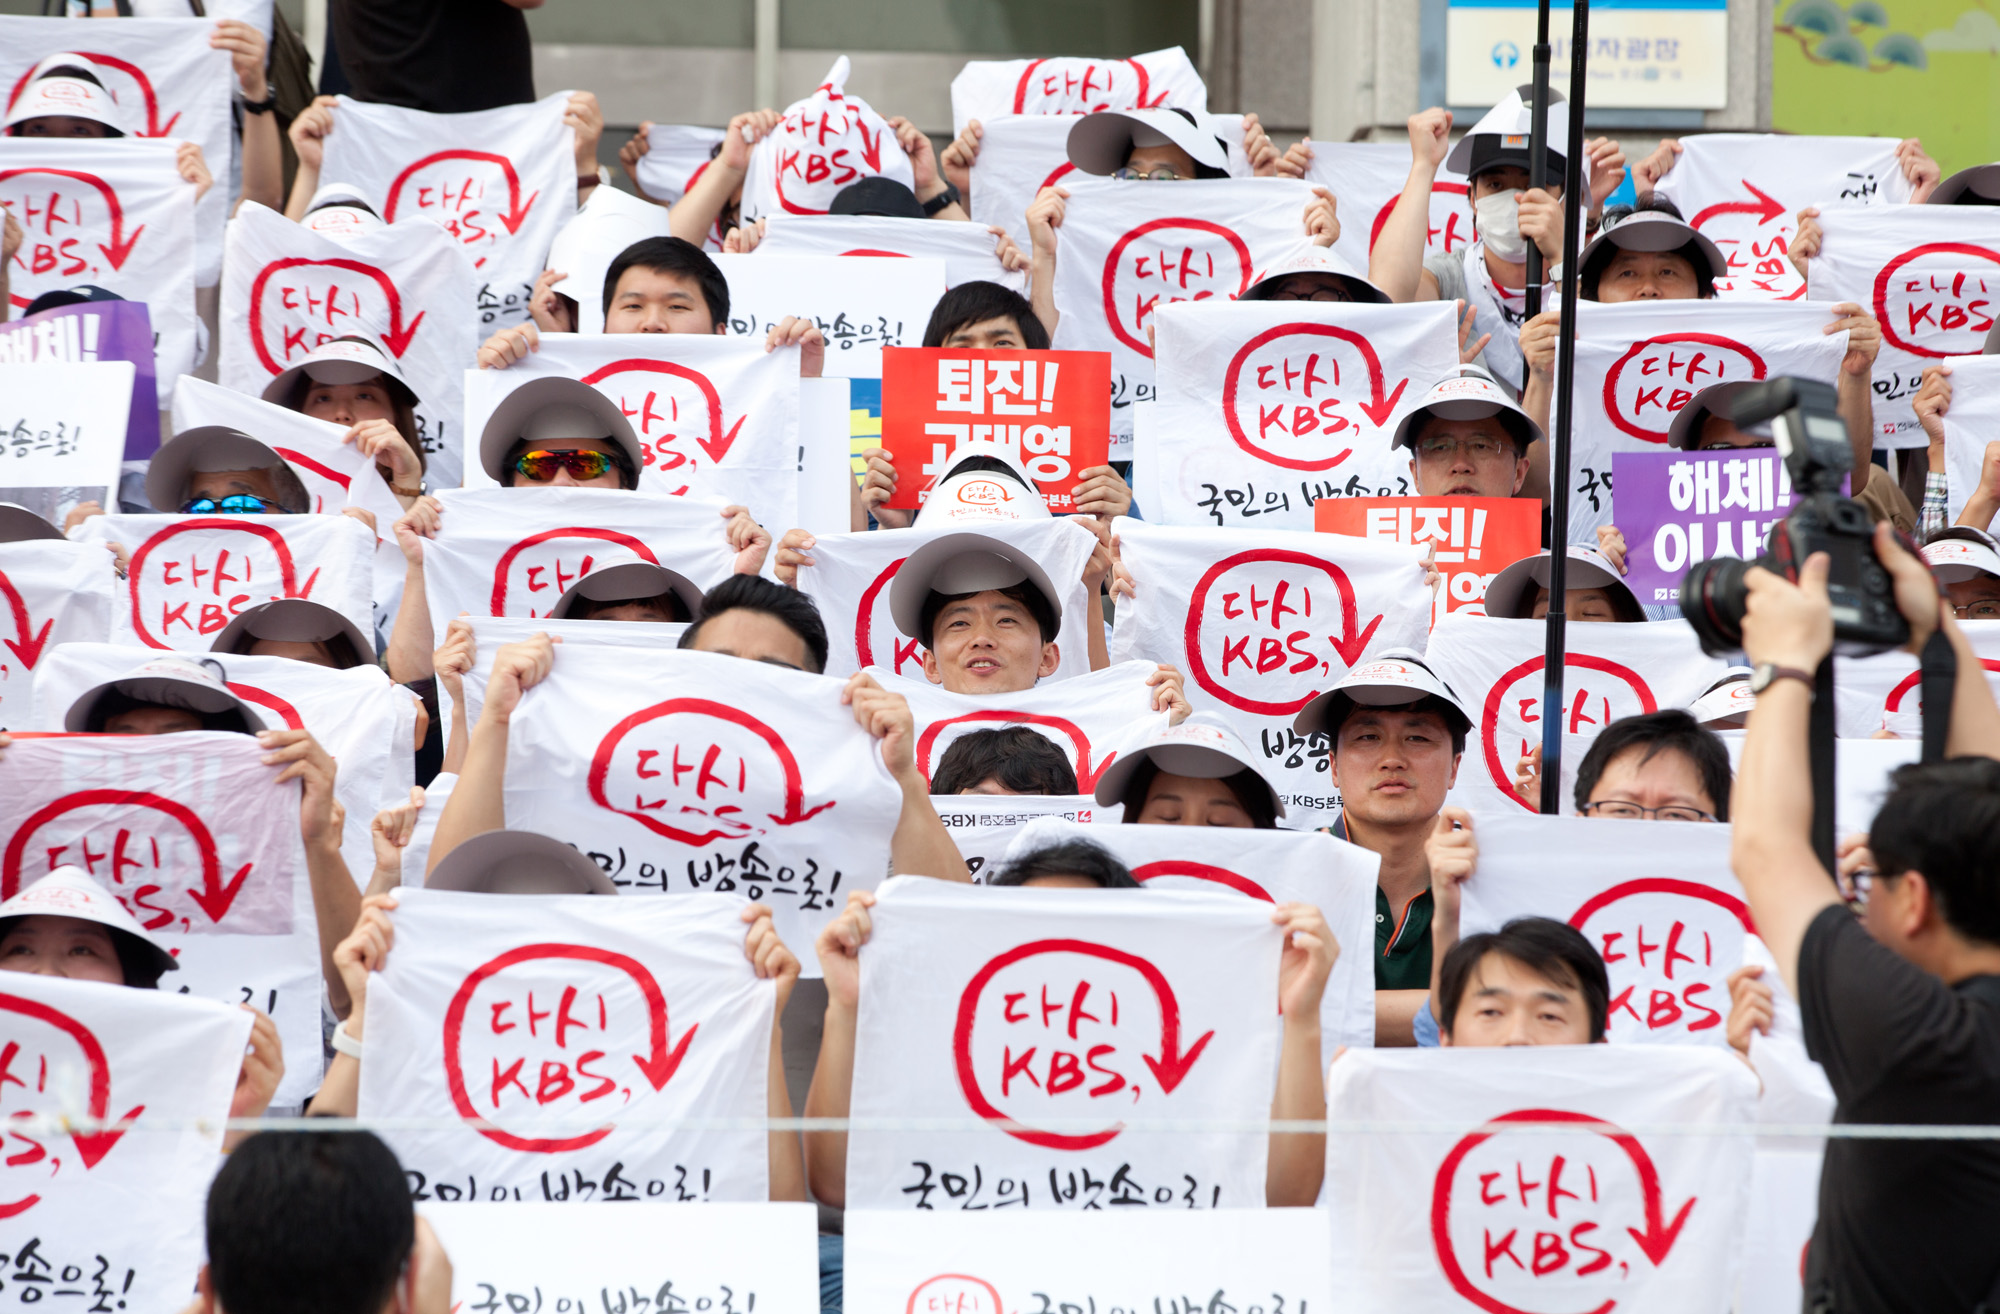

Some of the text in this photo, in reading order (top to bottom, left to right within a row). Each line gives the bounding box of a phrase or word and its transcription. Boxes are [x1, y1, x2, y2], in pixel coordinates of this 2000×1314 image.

[1043, 65, 1112, 103] 다시
[785, 106, 850, 147] 다시
[1507, 136, 1523, 145] NYC
[418, 177, 485, 212] 다시
[445, 209, 496, 246] BS,
[12, 237, 98, 280] BS,
[1135, 246, 1214, 290] 다시
[281, 284, 360, 326] 다시
[1904, 271, 1988, 299] 다시
[936, 359, 1060, 416] 퇴진!
[1257, 353, 1341, 399] 다시
[1641, 351, 1725, 384] 다시
[1258, 398, 1361, 440] KBS,
[1635, 386, 1706, 416] KB
[640, 433, 697, 473] BS,
[1197, 482, 1290, 527] 국민의
[1668, 457, 1792, 515] 해체!
[1653, 517, 1776, 574] 이사
[162, 549, 251, 597] 다시
[1222, 579, 1311, 629] 다시
[1222, 631, 1330, 678] KBS,
[636, 743, 746, 800] 다시
[687, 841, 842, 911] 방송으로!
[1601, 920, 1712, 980] 다시
[490, 985, 607, 1048] 다시
[1003, 980, 1119, 1040] 다시
[491, 1050, 631, 1108] KBS,
[1001, 1044, 1142, 1105] KBS,
[1479, 1155, 1599, 1220] 다시
[1484, 1221, 1630, 1280] KBS,
